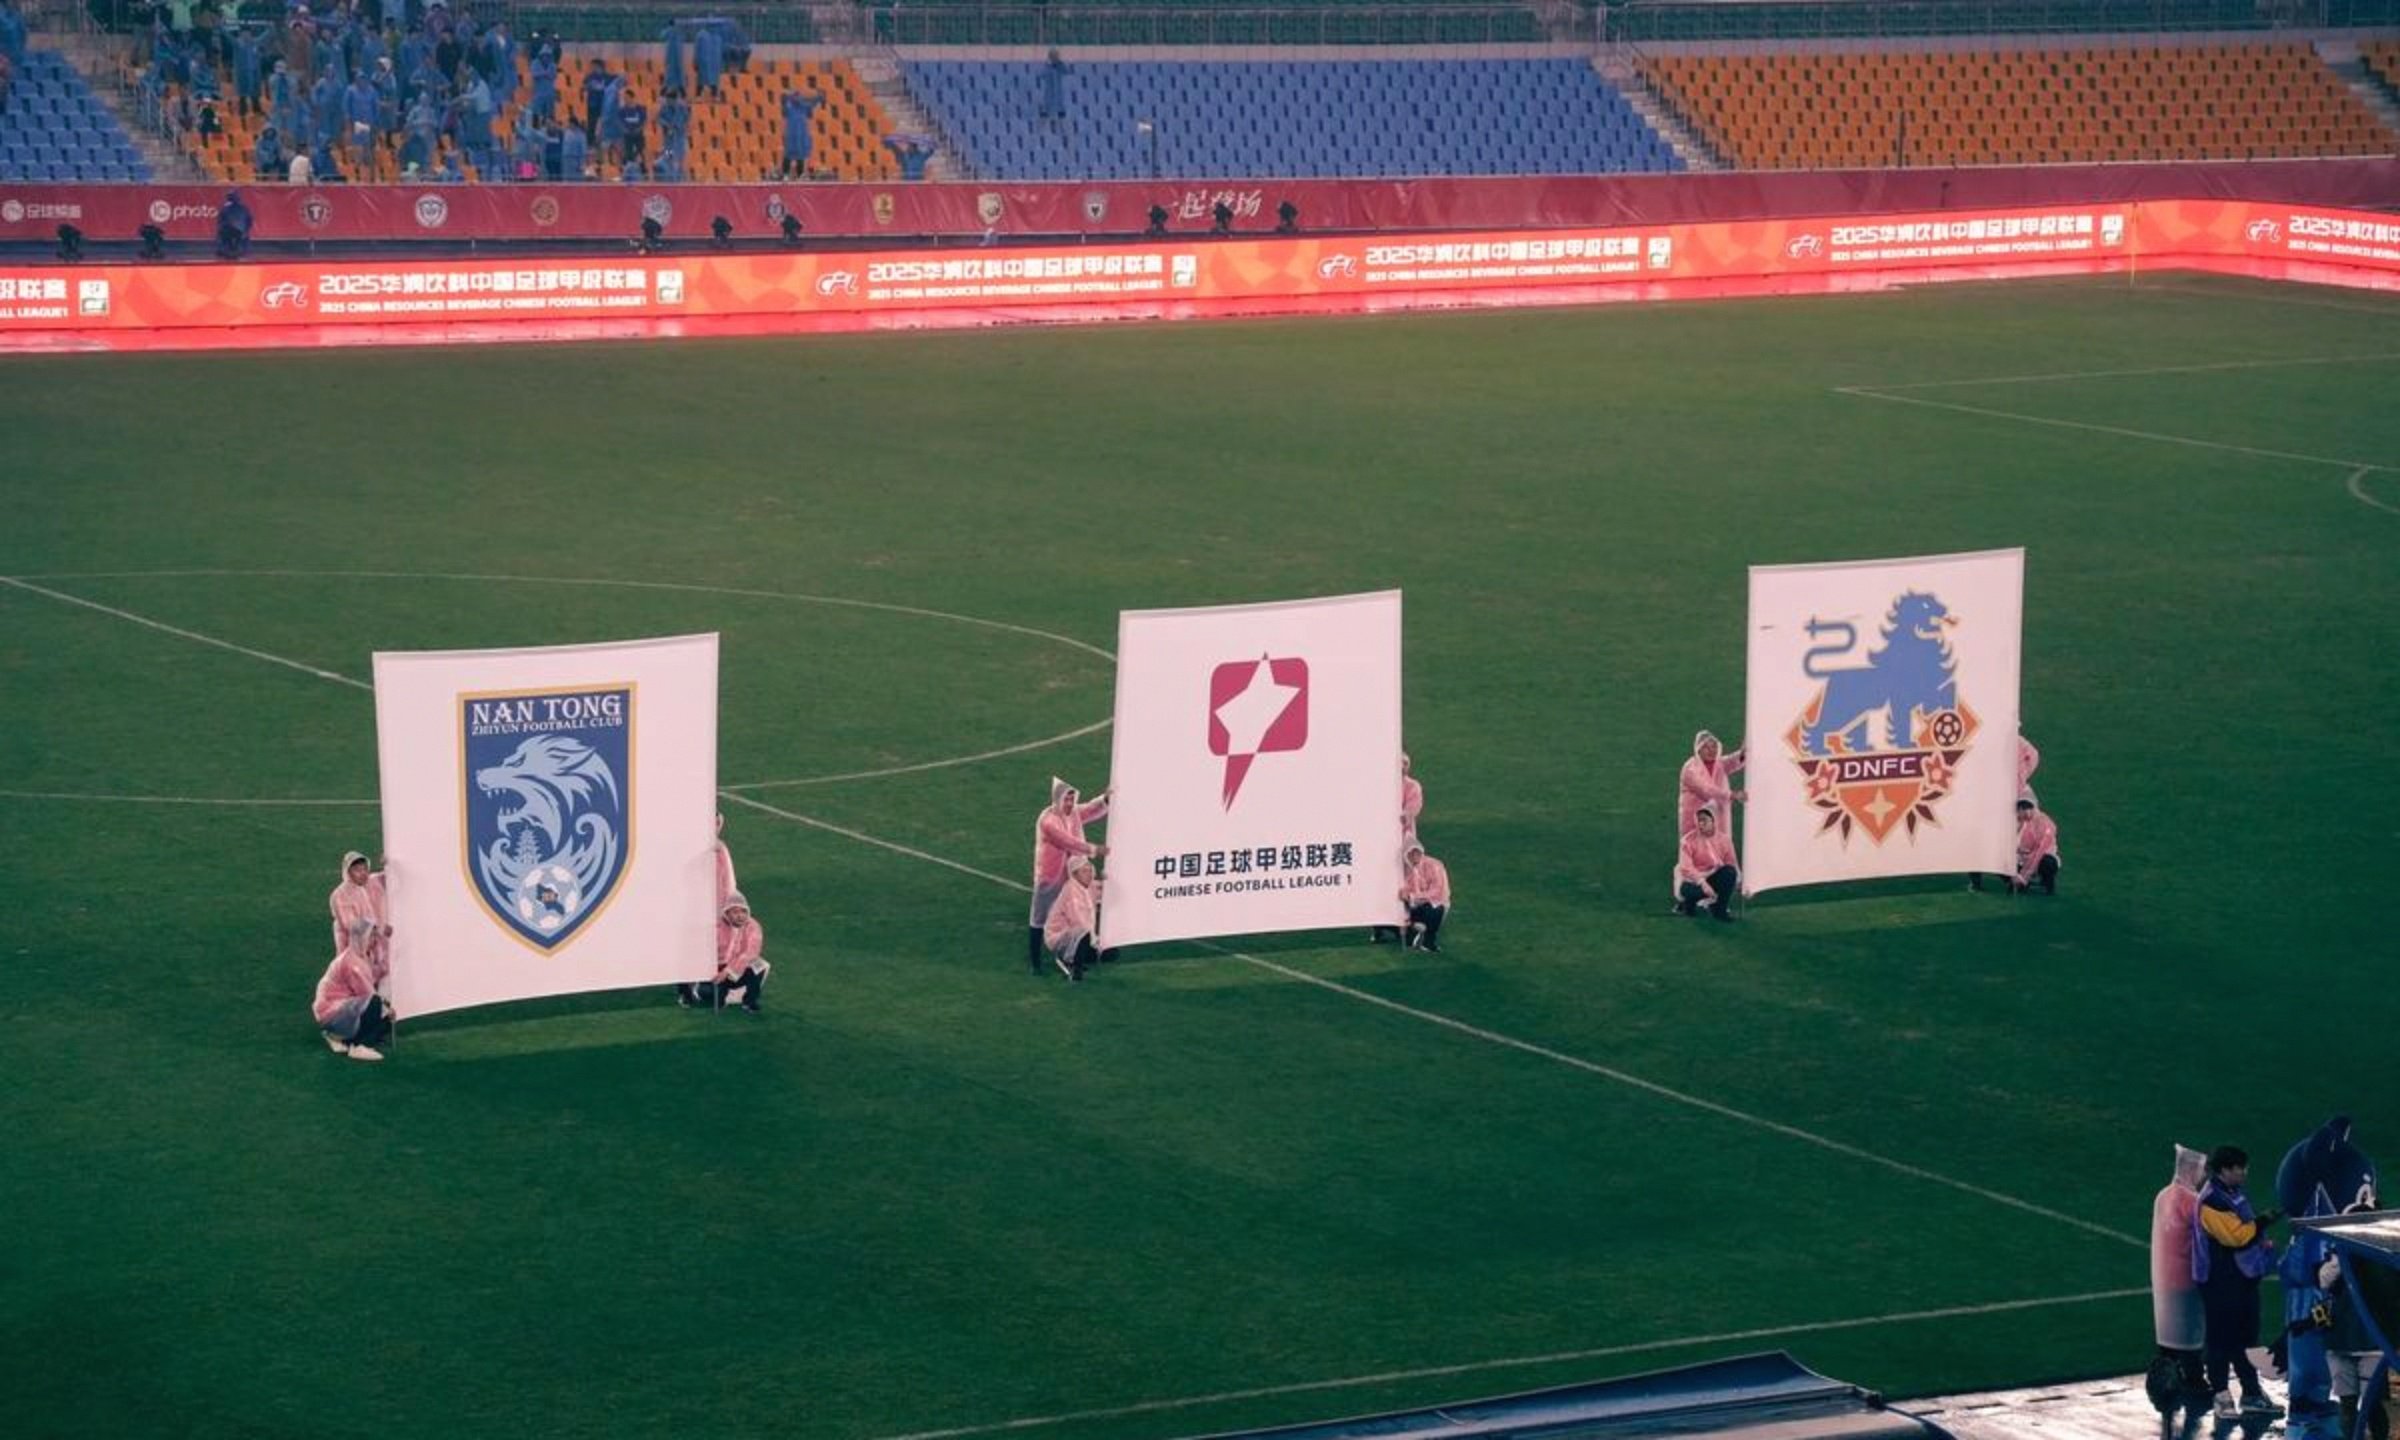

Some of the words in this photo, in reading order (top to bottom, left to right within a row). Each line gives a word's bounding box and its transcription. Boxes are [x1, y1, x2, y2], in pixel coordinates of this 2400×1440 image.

[472, 700, 534, 725] NAN
[543, 695, 622, 721] TONG
[472, 723, 519, 735] ZHIYUN
[523, 720, 585, 733] FOOTBALL
[590, 716, 623, 728] CLUB
[1843, 757, 1916, 778] DNFC
[1154, 841, 1353, 880] 中国足球甲级联赛
[1154, 883, 1212, 899] CHINESE
[1216, 878, 1285, 893] FOOTBALL
[1289, 874, 1341, 888] LEAGUE
[1346, 874, 1352, 886] 1
